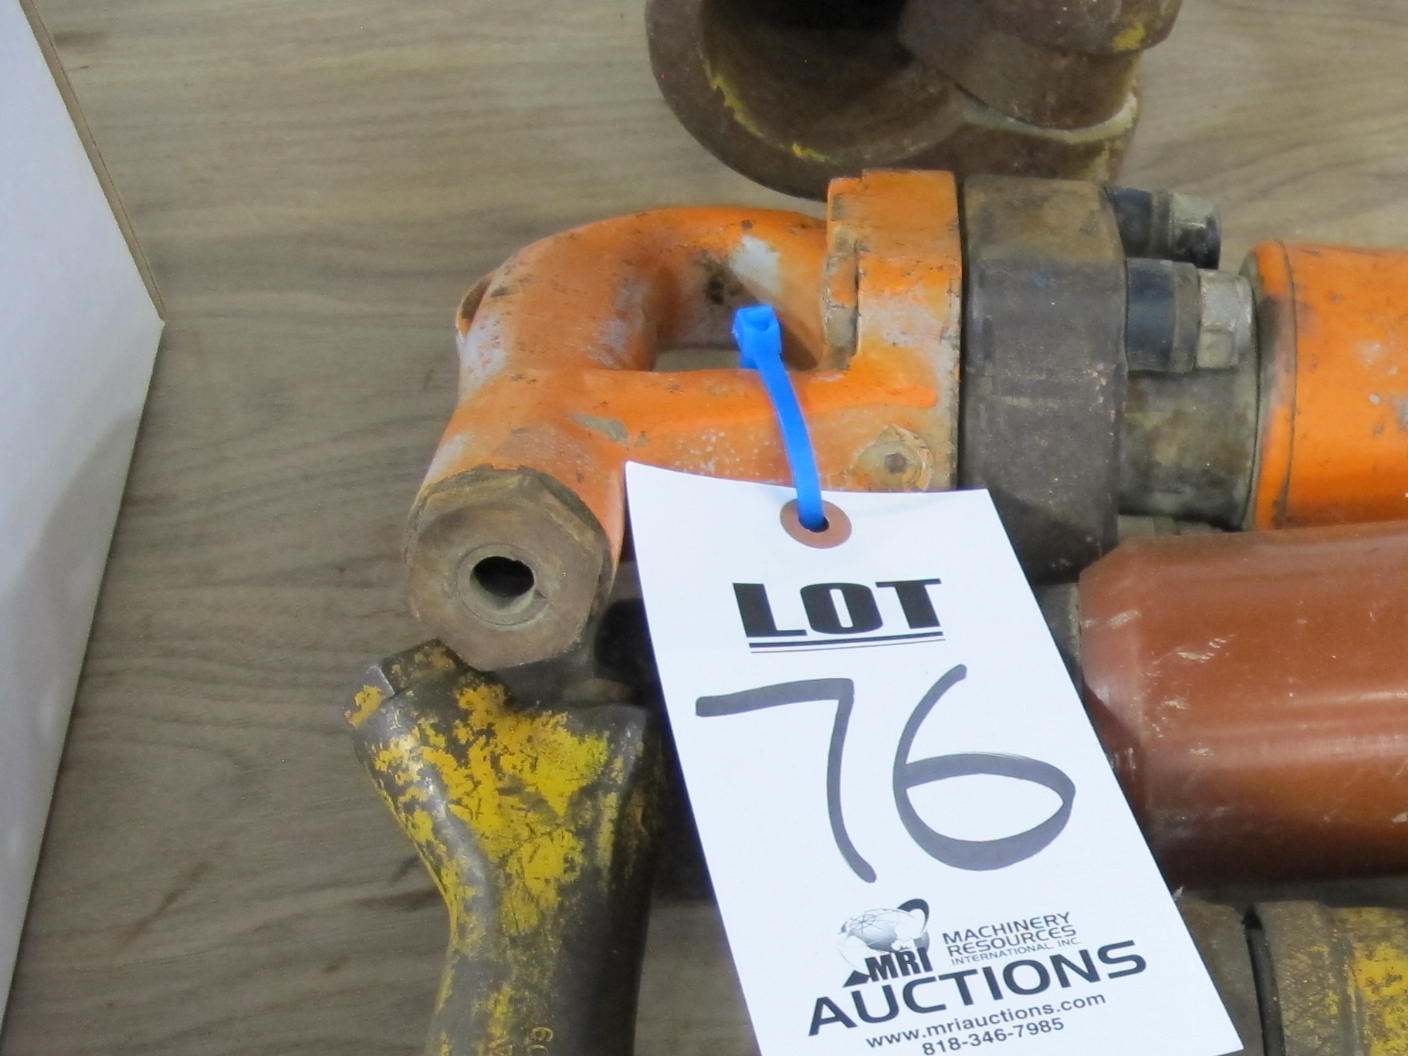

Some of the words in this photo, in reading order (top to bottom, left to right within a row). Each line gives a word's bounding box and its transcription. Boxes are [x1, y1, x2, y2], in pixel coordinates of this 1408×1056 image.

[732, 578, 942, 637] LOT
[695, 663, 1076, 883] 76
[942, 911, 1070, 945] MACHINERY
[946, 924, 1077, 957] RESOURCES
[864, 947, 934, 983] MRI
[951, 943, 1053, 966] INTERNATIONAL
[808, 940, 1147, 1036] AUCTIONS
[865, 991, 1107, 1049] www.mriauctions.com
[922, 1017, 1064, 1056] 818-346-7985
